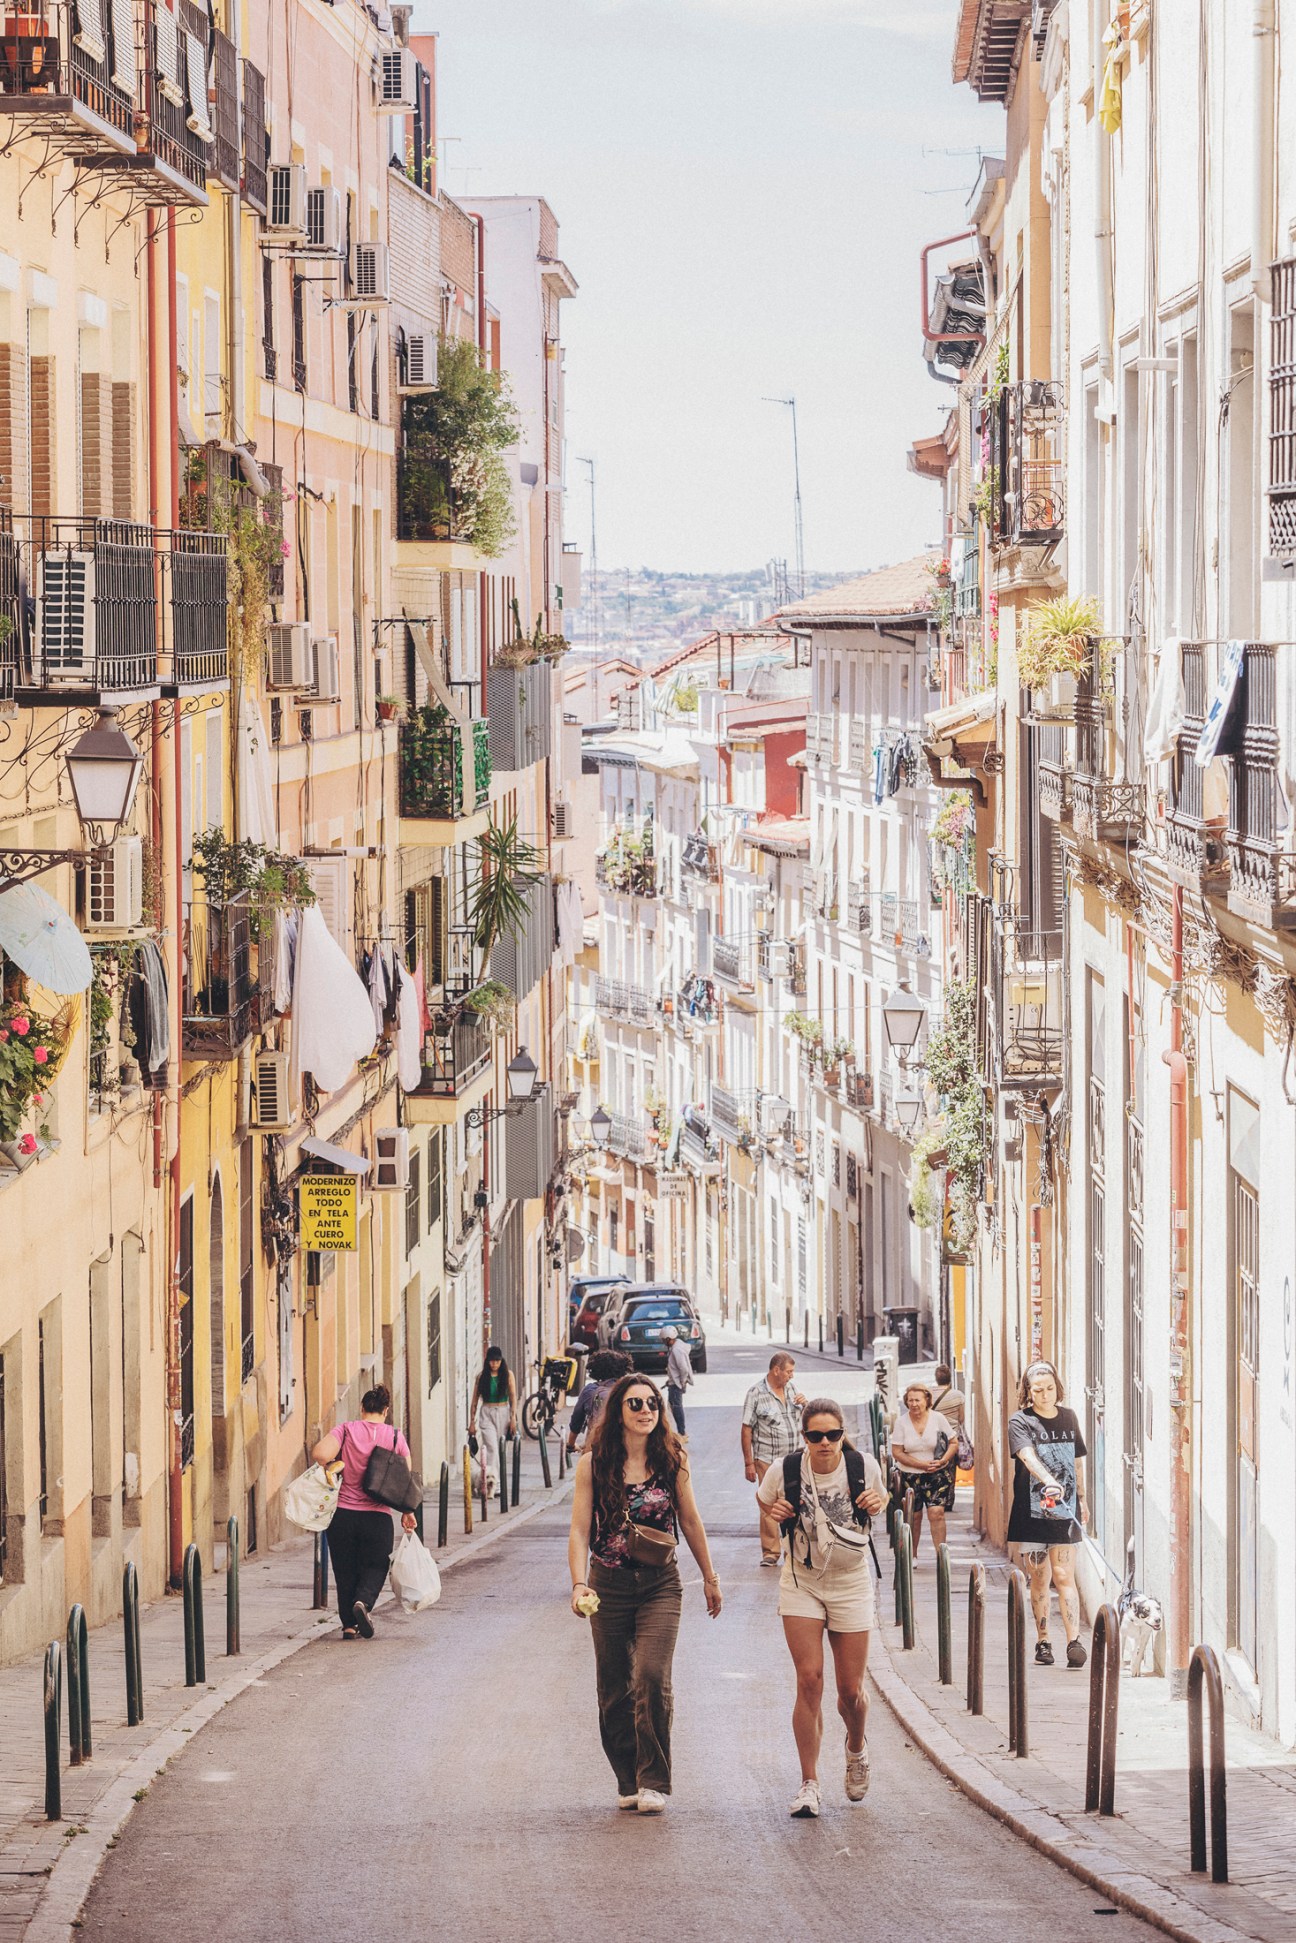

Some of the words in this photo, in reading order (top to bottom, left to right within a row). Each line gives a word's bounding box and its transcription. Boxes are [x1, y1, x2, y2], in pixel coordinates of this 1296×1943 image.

[302, 1177, 356, 1186] MODERNIZO
[307, 1188, 351, 1197] ARREGLO
[315, 1199, 343, 1207] TODO
[308, 1209, 321, 1217] EN
[327, 1209, 349, 1217] TELA
[317, 1219, 342, 1228] ANTE
[313, 1230, 344, 1239] CUERO
[306, 1241, 312, 1249] Y
[318, 1241, 352, 1249] NOVAK
